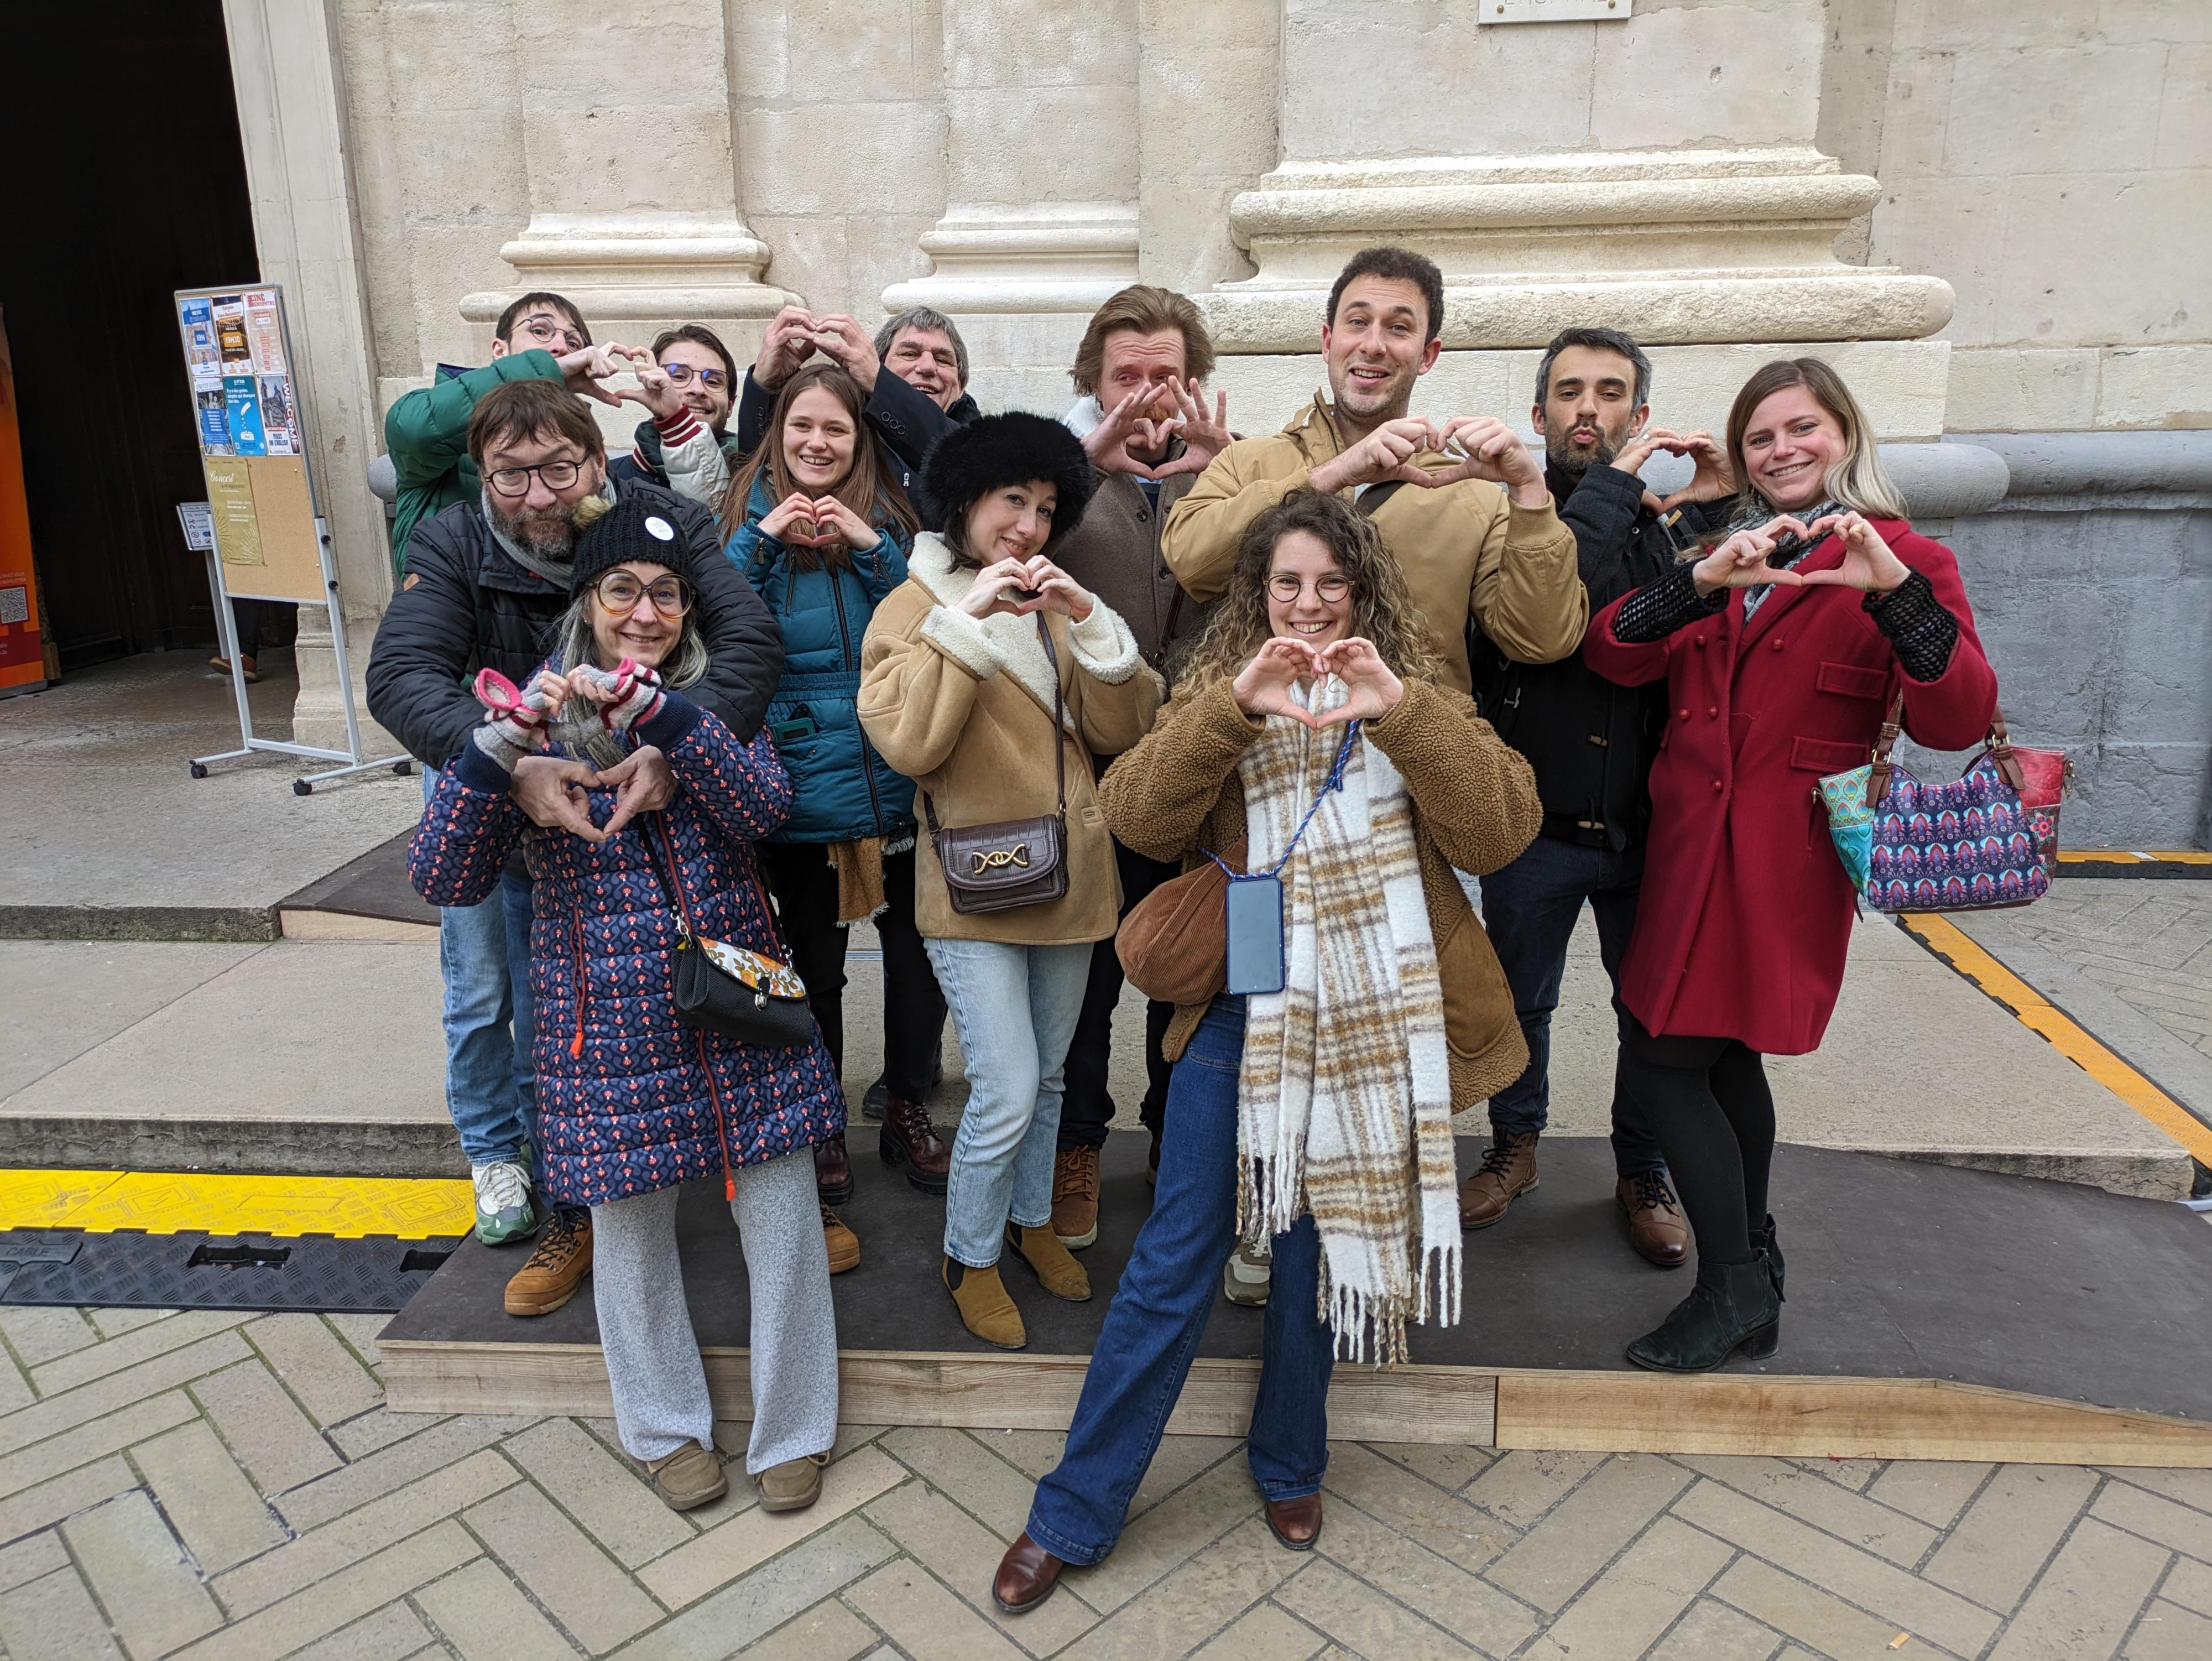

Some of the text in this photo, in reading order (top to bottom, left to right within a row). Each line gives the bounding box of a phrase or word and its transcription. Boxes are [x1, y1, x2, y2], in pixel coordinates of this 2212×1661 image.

[283, 383, 299, 445] WELCOME
[210, 470, 234, 482] Concert
[6, 1247, 52, 1257] CABLE
